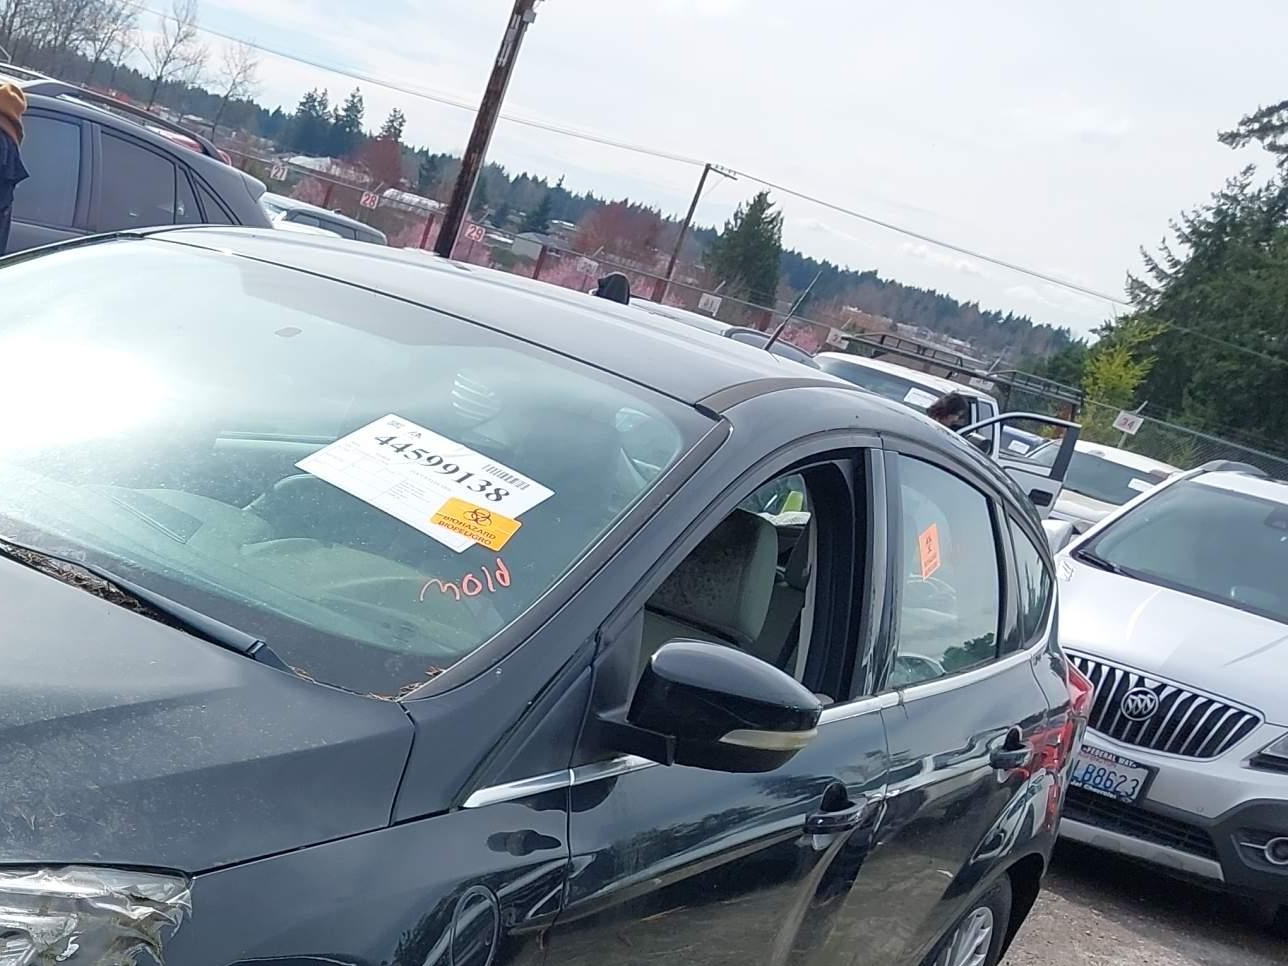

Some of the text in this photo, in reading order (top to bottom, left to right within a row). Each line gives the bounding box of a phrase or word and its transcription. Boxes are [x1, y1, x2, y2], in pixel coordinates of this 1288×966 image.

[272, 165, 287, 179] 27
[362, 192, 377, 207] 28
[466, 225, 483, 241] 29
[1121, 417, 1136, 430] 34
[374, 434, 512, 503] 44599138
[438, 520, 492, 546] BIOPELIGRO
[442, 515, 497, 540] BIOHAZARD
[1087, 746, 1116, 762] FEDERAL
[1118, 757, 1134, 768] WAY
